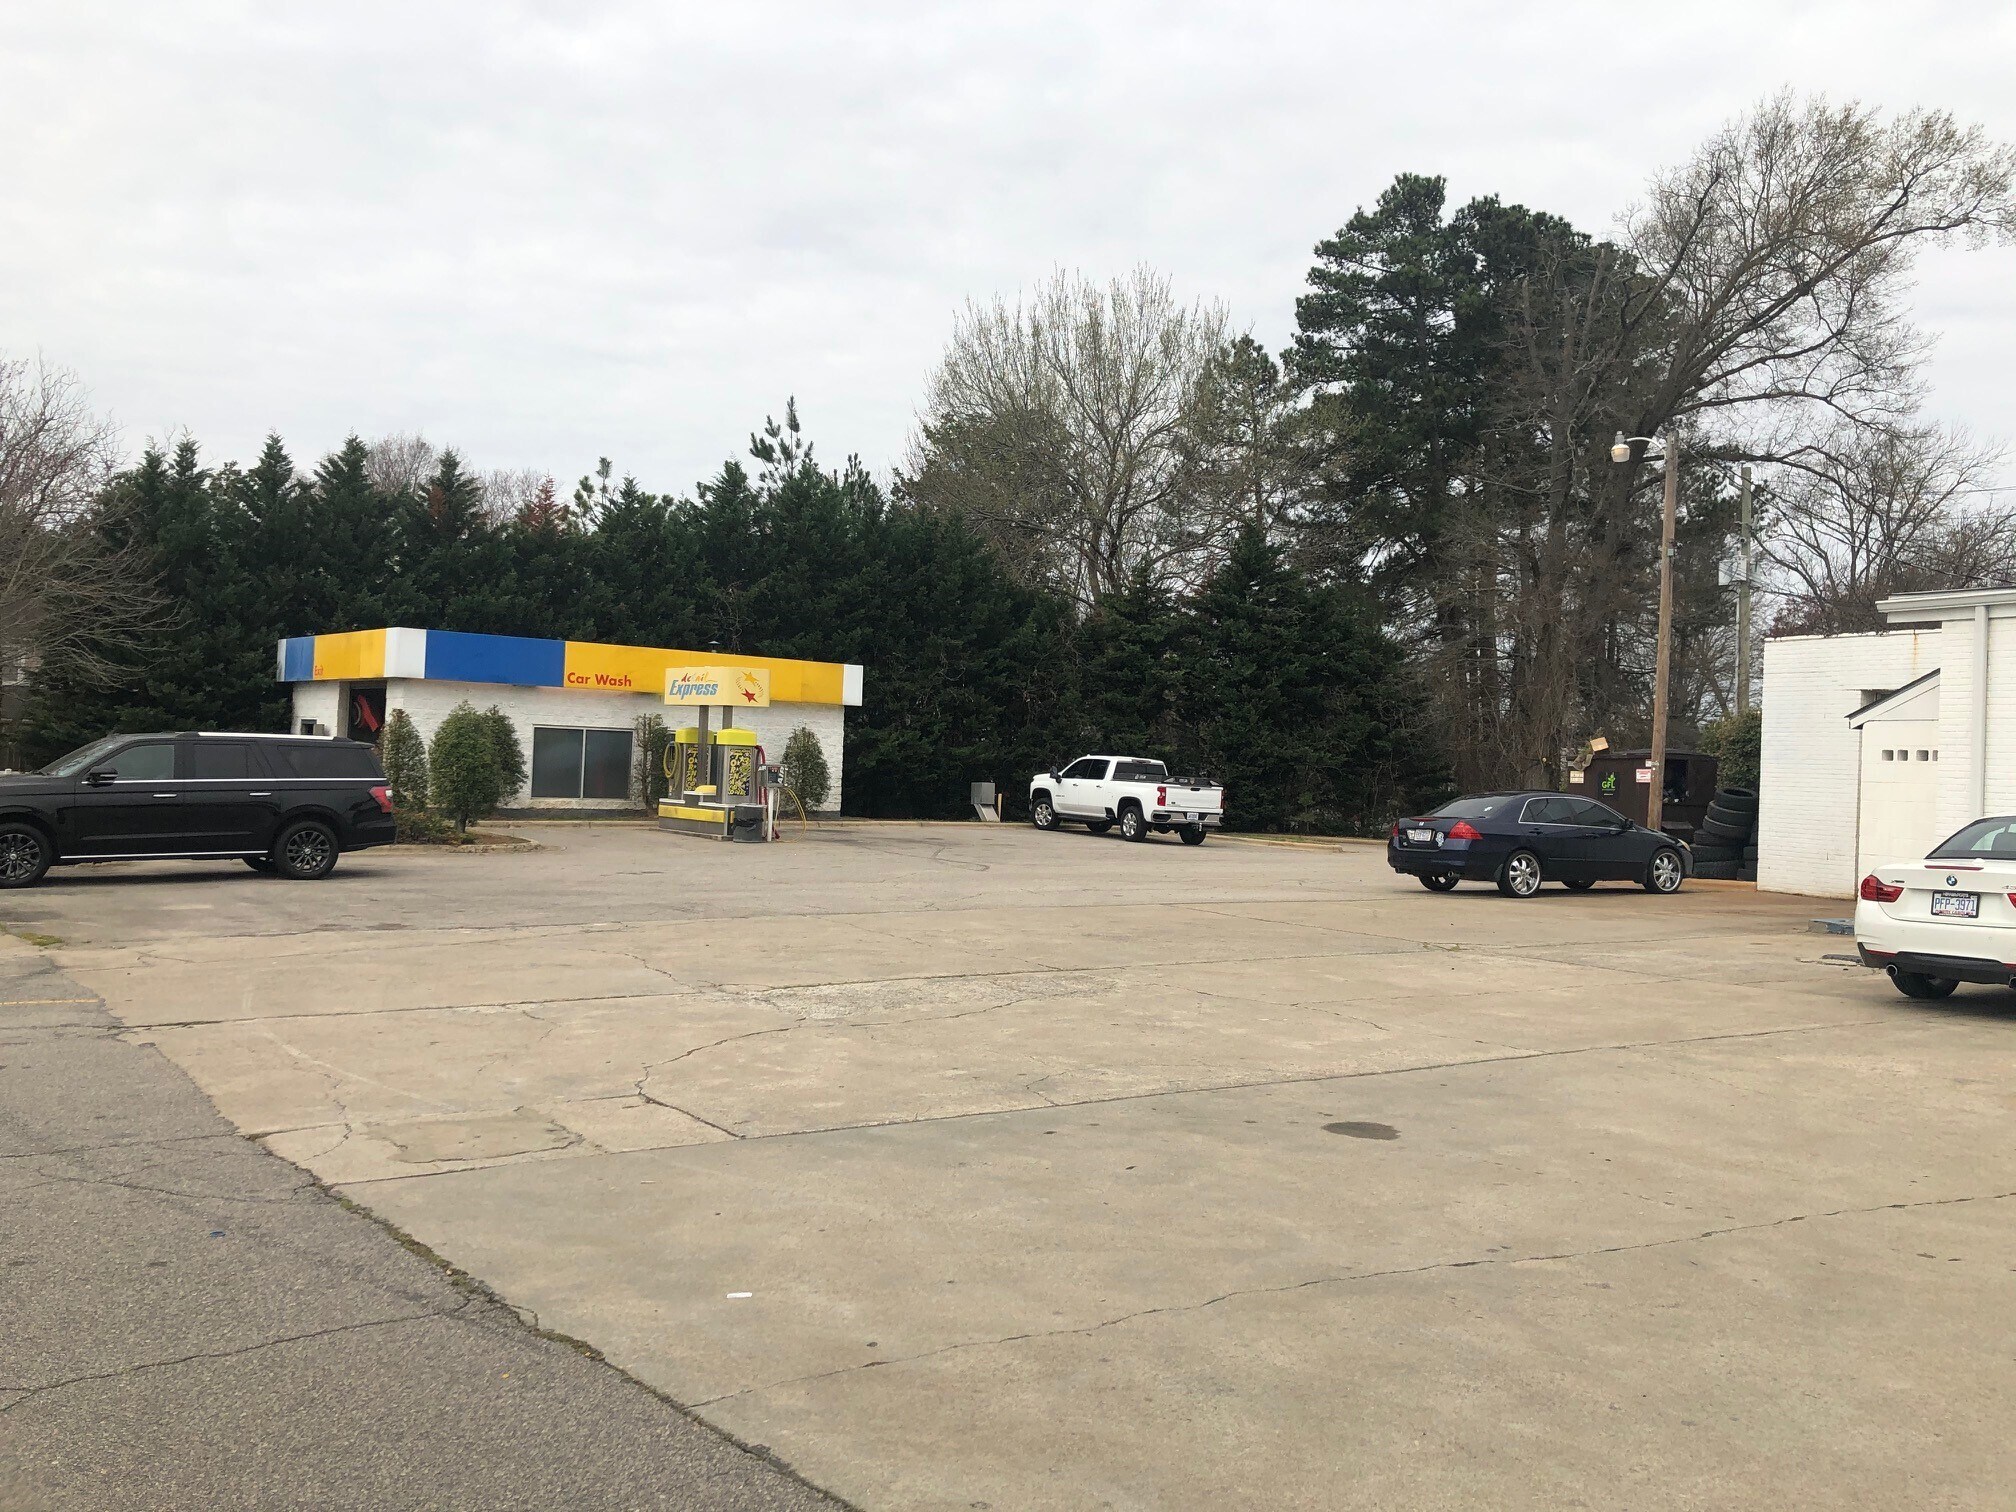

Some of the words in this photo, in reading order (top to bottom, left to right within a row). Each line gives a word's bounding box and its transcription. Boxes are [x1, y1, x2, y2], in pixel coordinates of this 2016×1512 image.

[567, 672, 591, 684] Car
[595, 674, 632, 687] Wash
[669, 680, 718, 700] Express
[1934, 897, 1975, 911] PFP-3971
